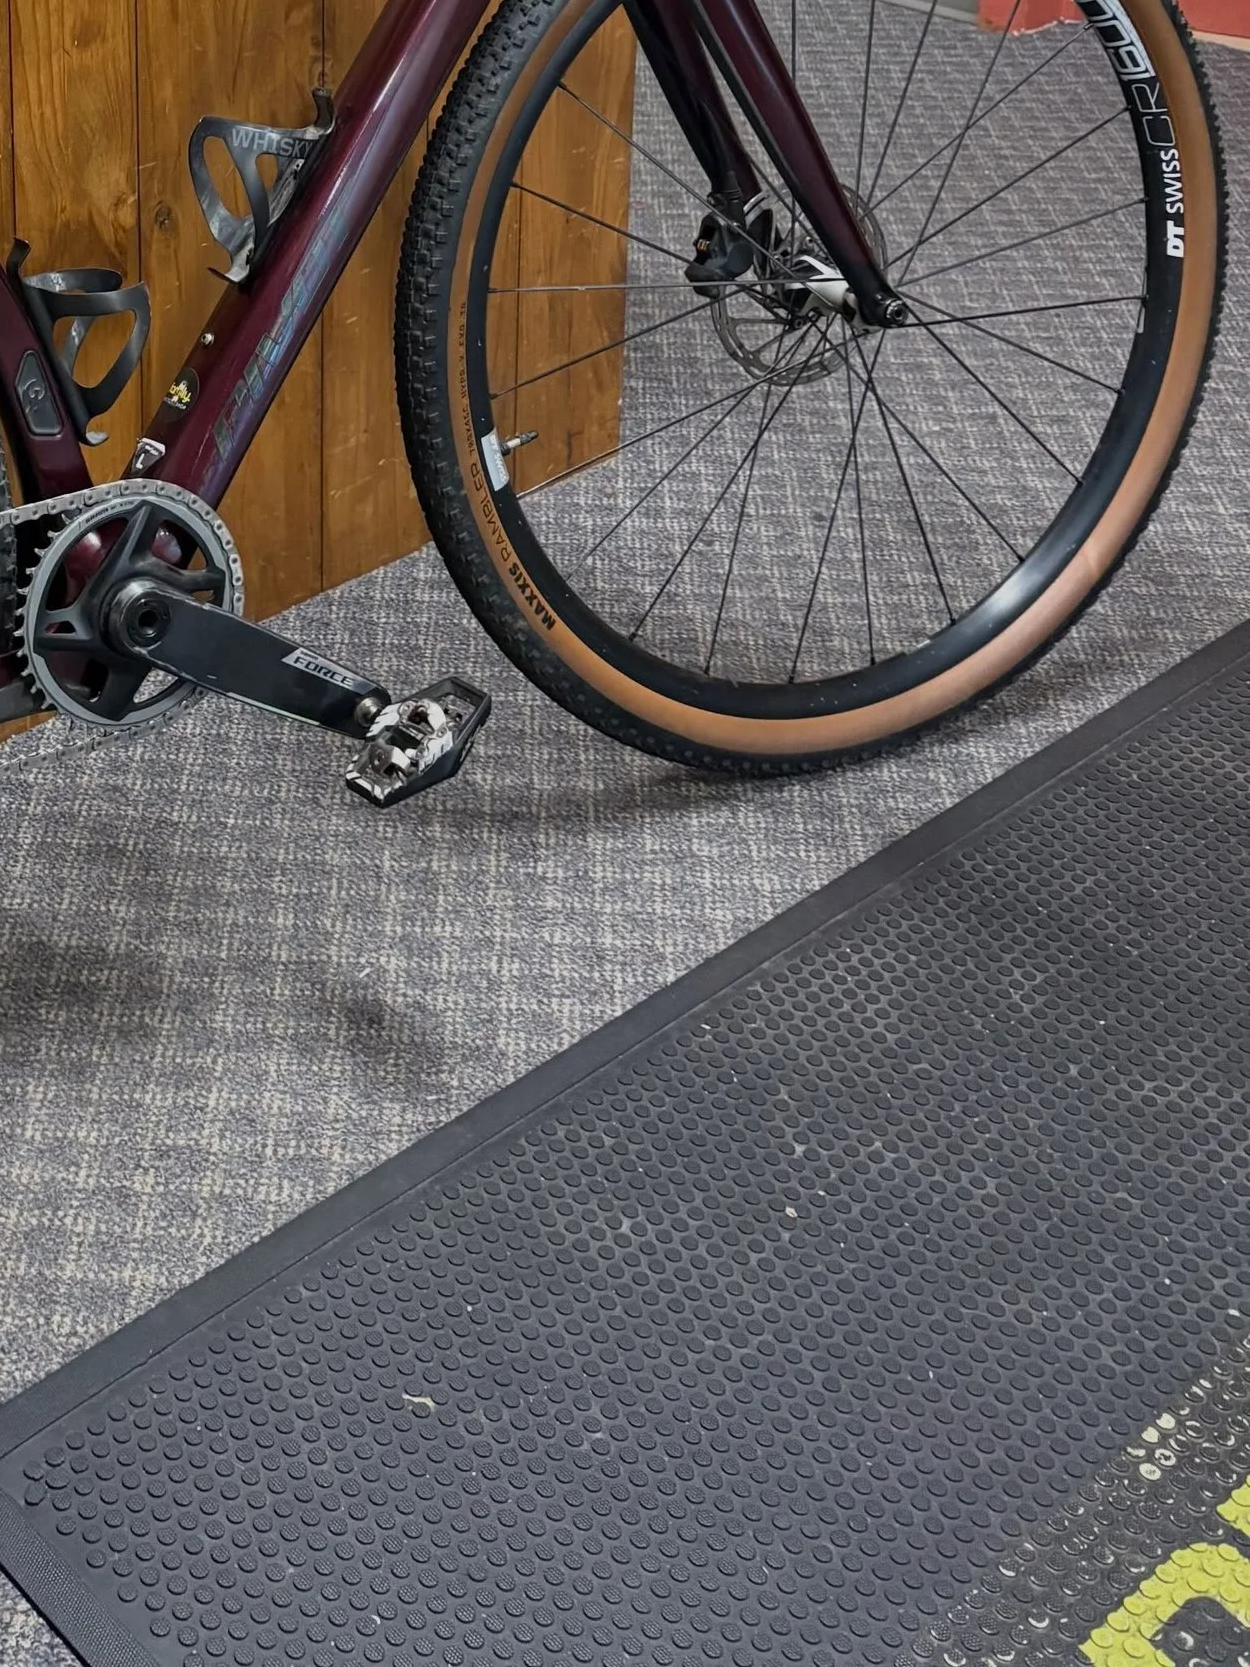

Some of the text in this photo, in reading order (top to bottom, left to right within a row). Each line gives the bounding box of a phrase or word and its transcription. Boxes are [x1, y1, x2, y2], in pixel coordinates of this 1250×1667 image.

[232, 128, 312, 159] WHISKY
[1162, 148, 1185, 214] SWISS
[1166, 220, 1185, 258] DT
[470, 461, 512, 563] RAMBLER
[508, 561, 557, 632] MAXXIS
[293, 655, 356, 688] FORCE
